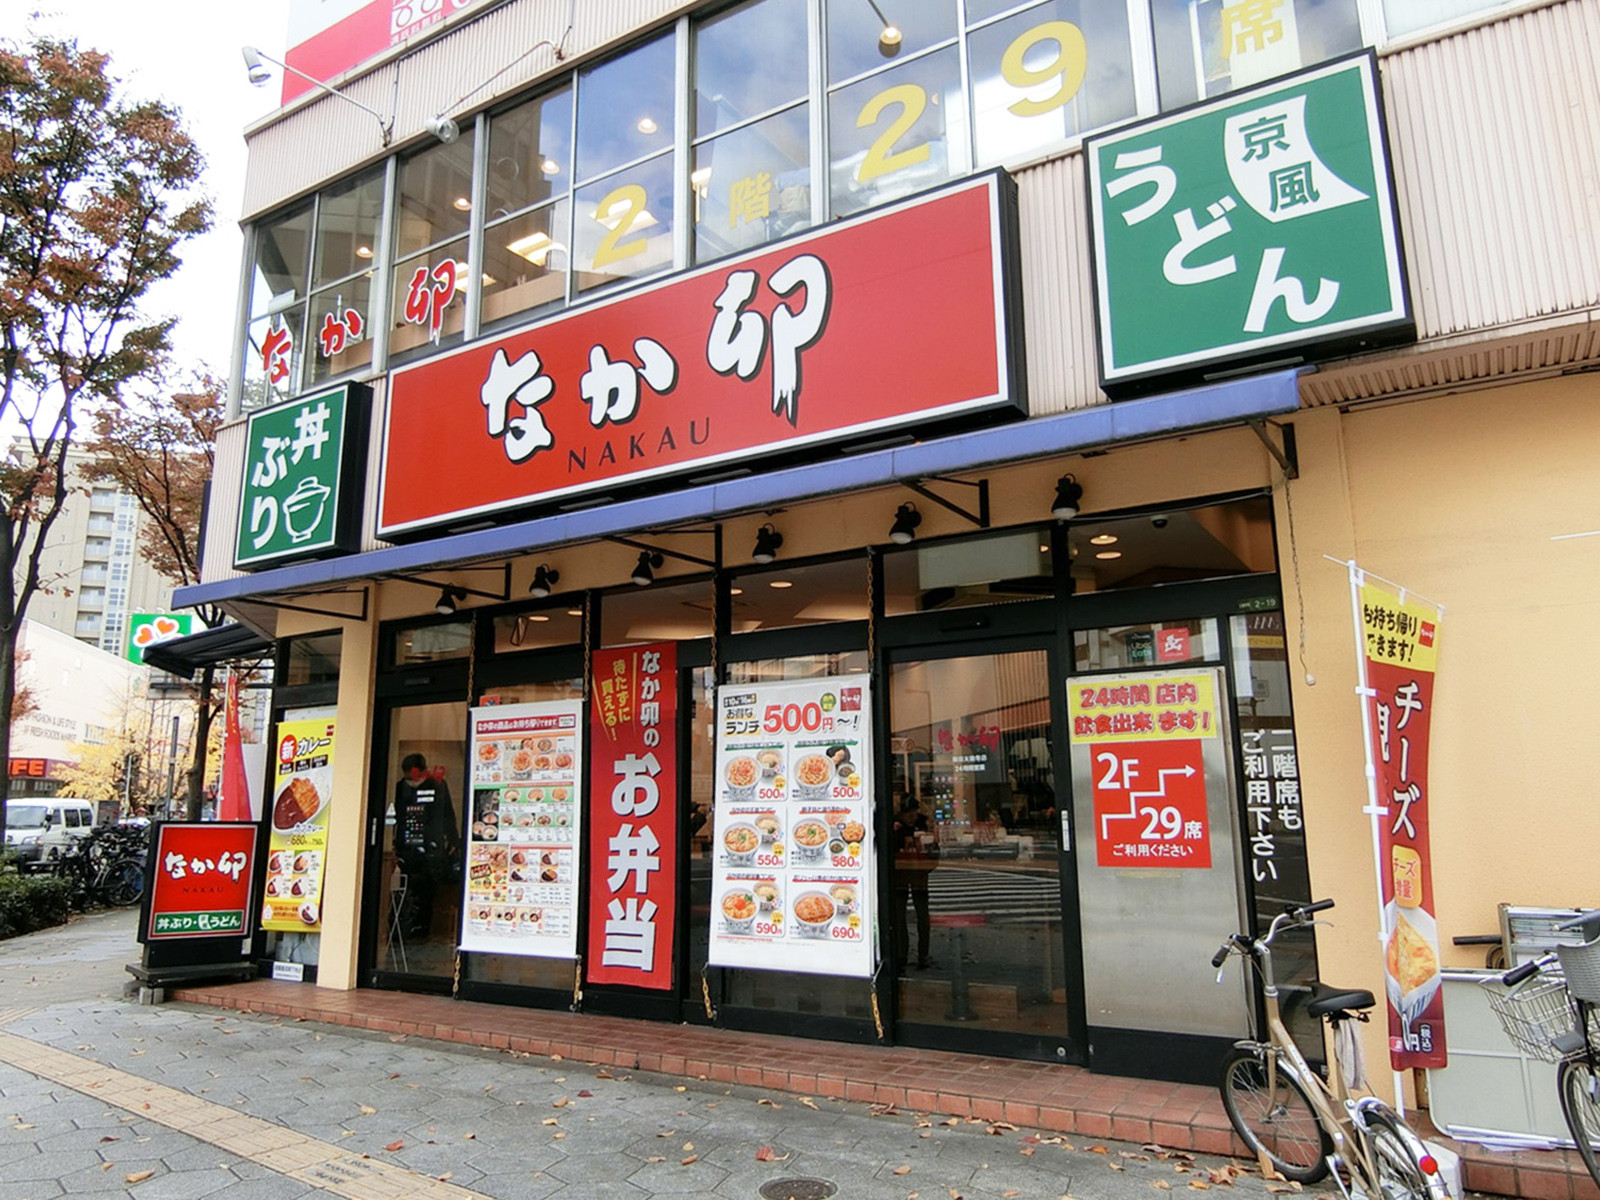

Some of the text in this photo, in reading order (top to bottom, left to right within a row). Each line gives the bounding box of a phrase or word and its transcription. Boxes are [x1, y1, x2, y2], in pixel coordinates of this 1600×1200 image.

[1240, 113, 1320, 213] 京風
[1105, 146, 1340, 333] うどん
[261, 258, 456, 385] なか卯
[480, 253, 832, 463] なか卯
[250, 401, 331, 550] 丼ぶり
[566, 417, 712, 474] NAKAU
[640, 651, 661, 748] なか卯の
[726, 720, 760, 735] ランチ
[1074, 711, 1152, 736] 飲食出来
[1080, 682, 1197, 709] 24時間 店内
[10, 759, 45, 776] FE
[1097, 752, 1139, 789] 2F
[1243, 728, 1277, 882] ご利用下さい
[1271, 729, 1302, 830] 二階席も
[1394, 681, 1423, 839] チーズ
[165, 851, 247, 883] なか卯
[602, 752, 662, 973] お弁当
[1113, 843, 1194, 857] ご利用ください
[1140, 806, 1202, 840] 29席
